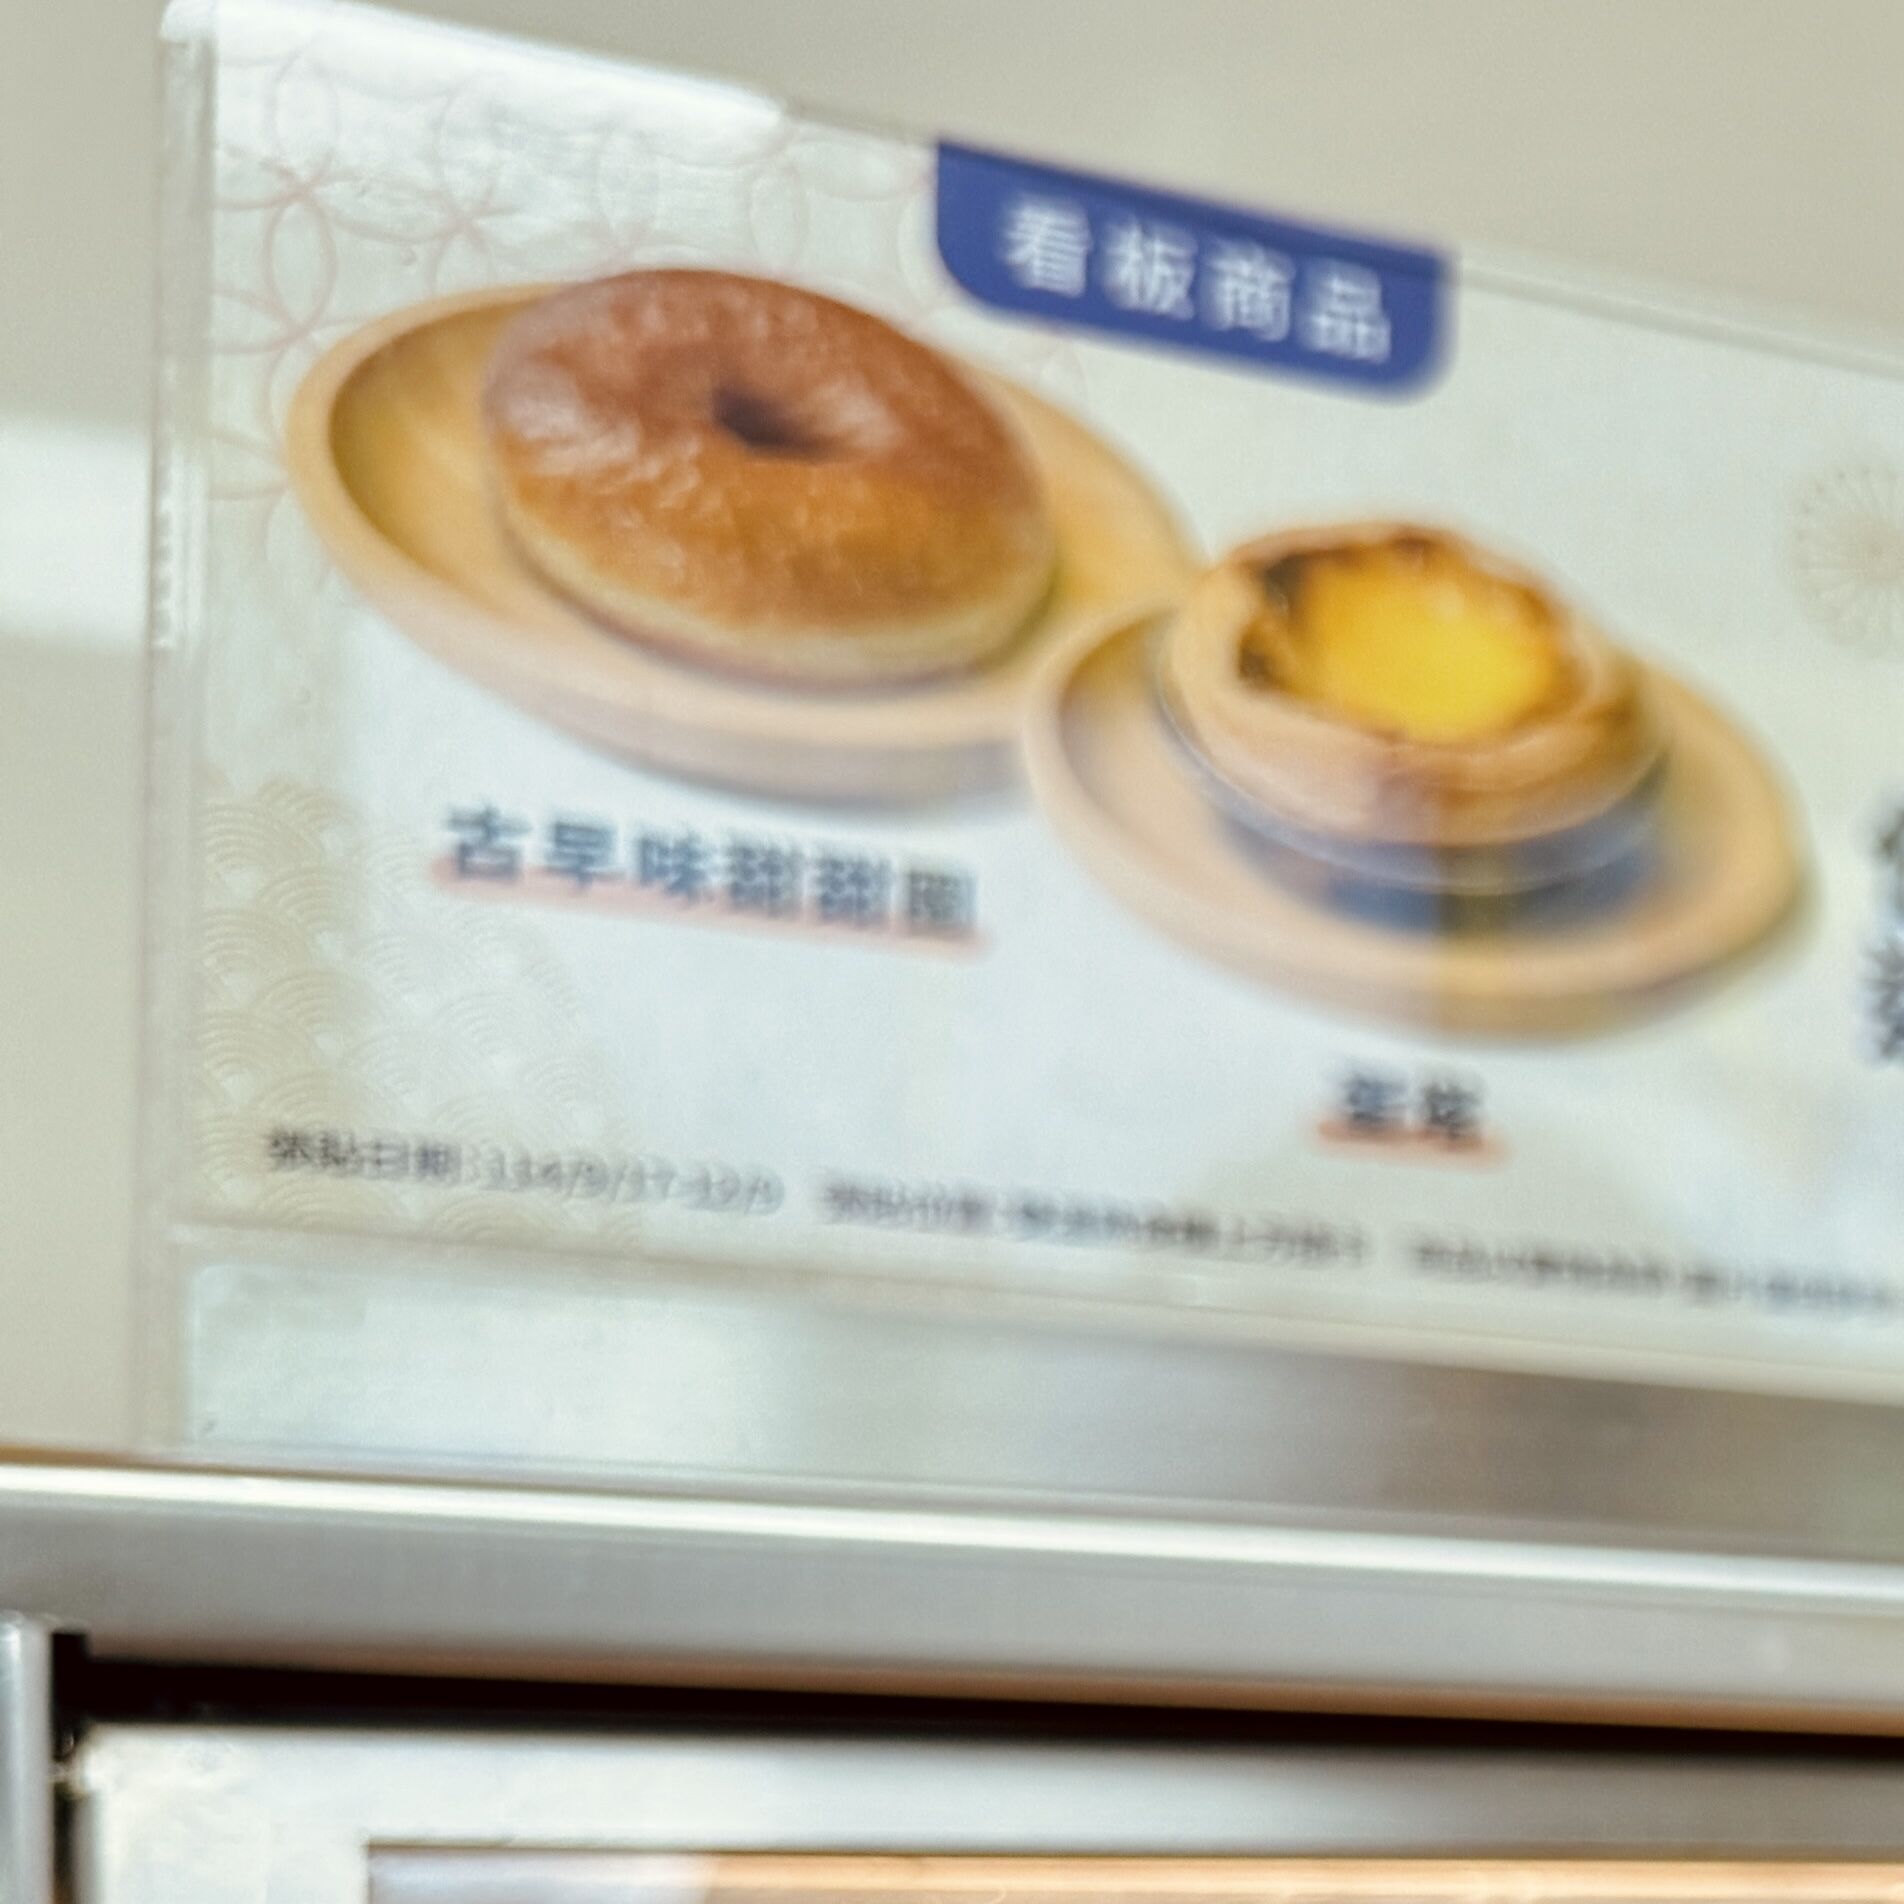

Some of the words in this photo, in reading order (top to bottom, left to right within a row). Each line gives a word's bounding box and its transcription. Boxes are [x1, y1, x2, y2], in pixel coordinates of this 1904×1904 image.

[1001, 193, 1392, 364] 看板商品
[446, 803, 978, 937] 古早味甜甜圈
